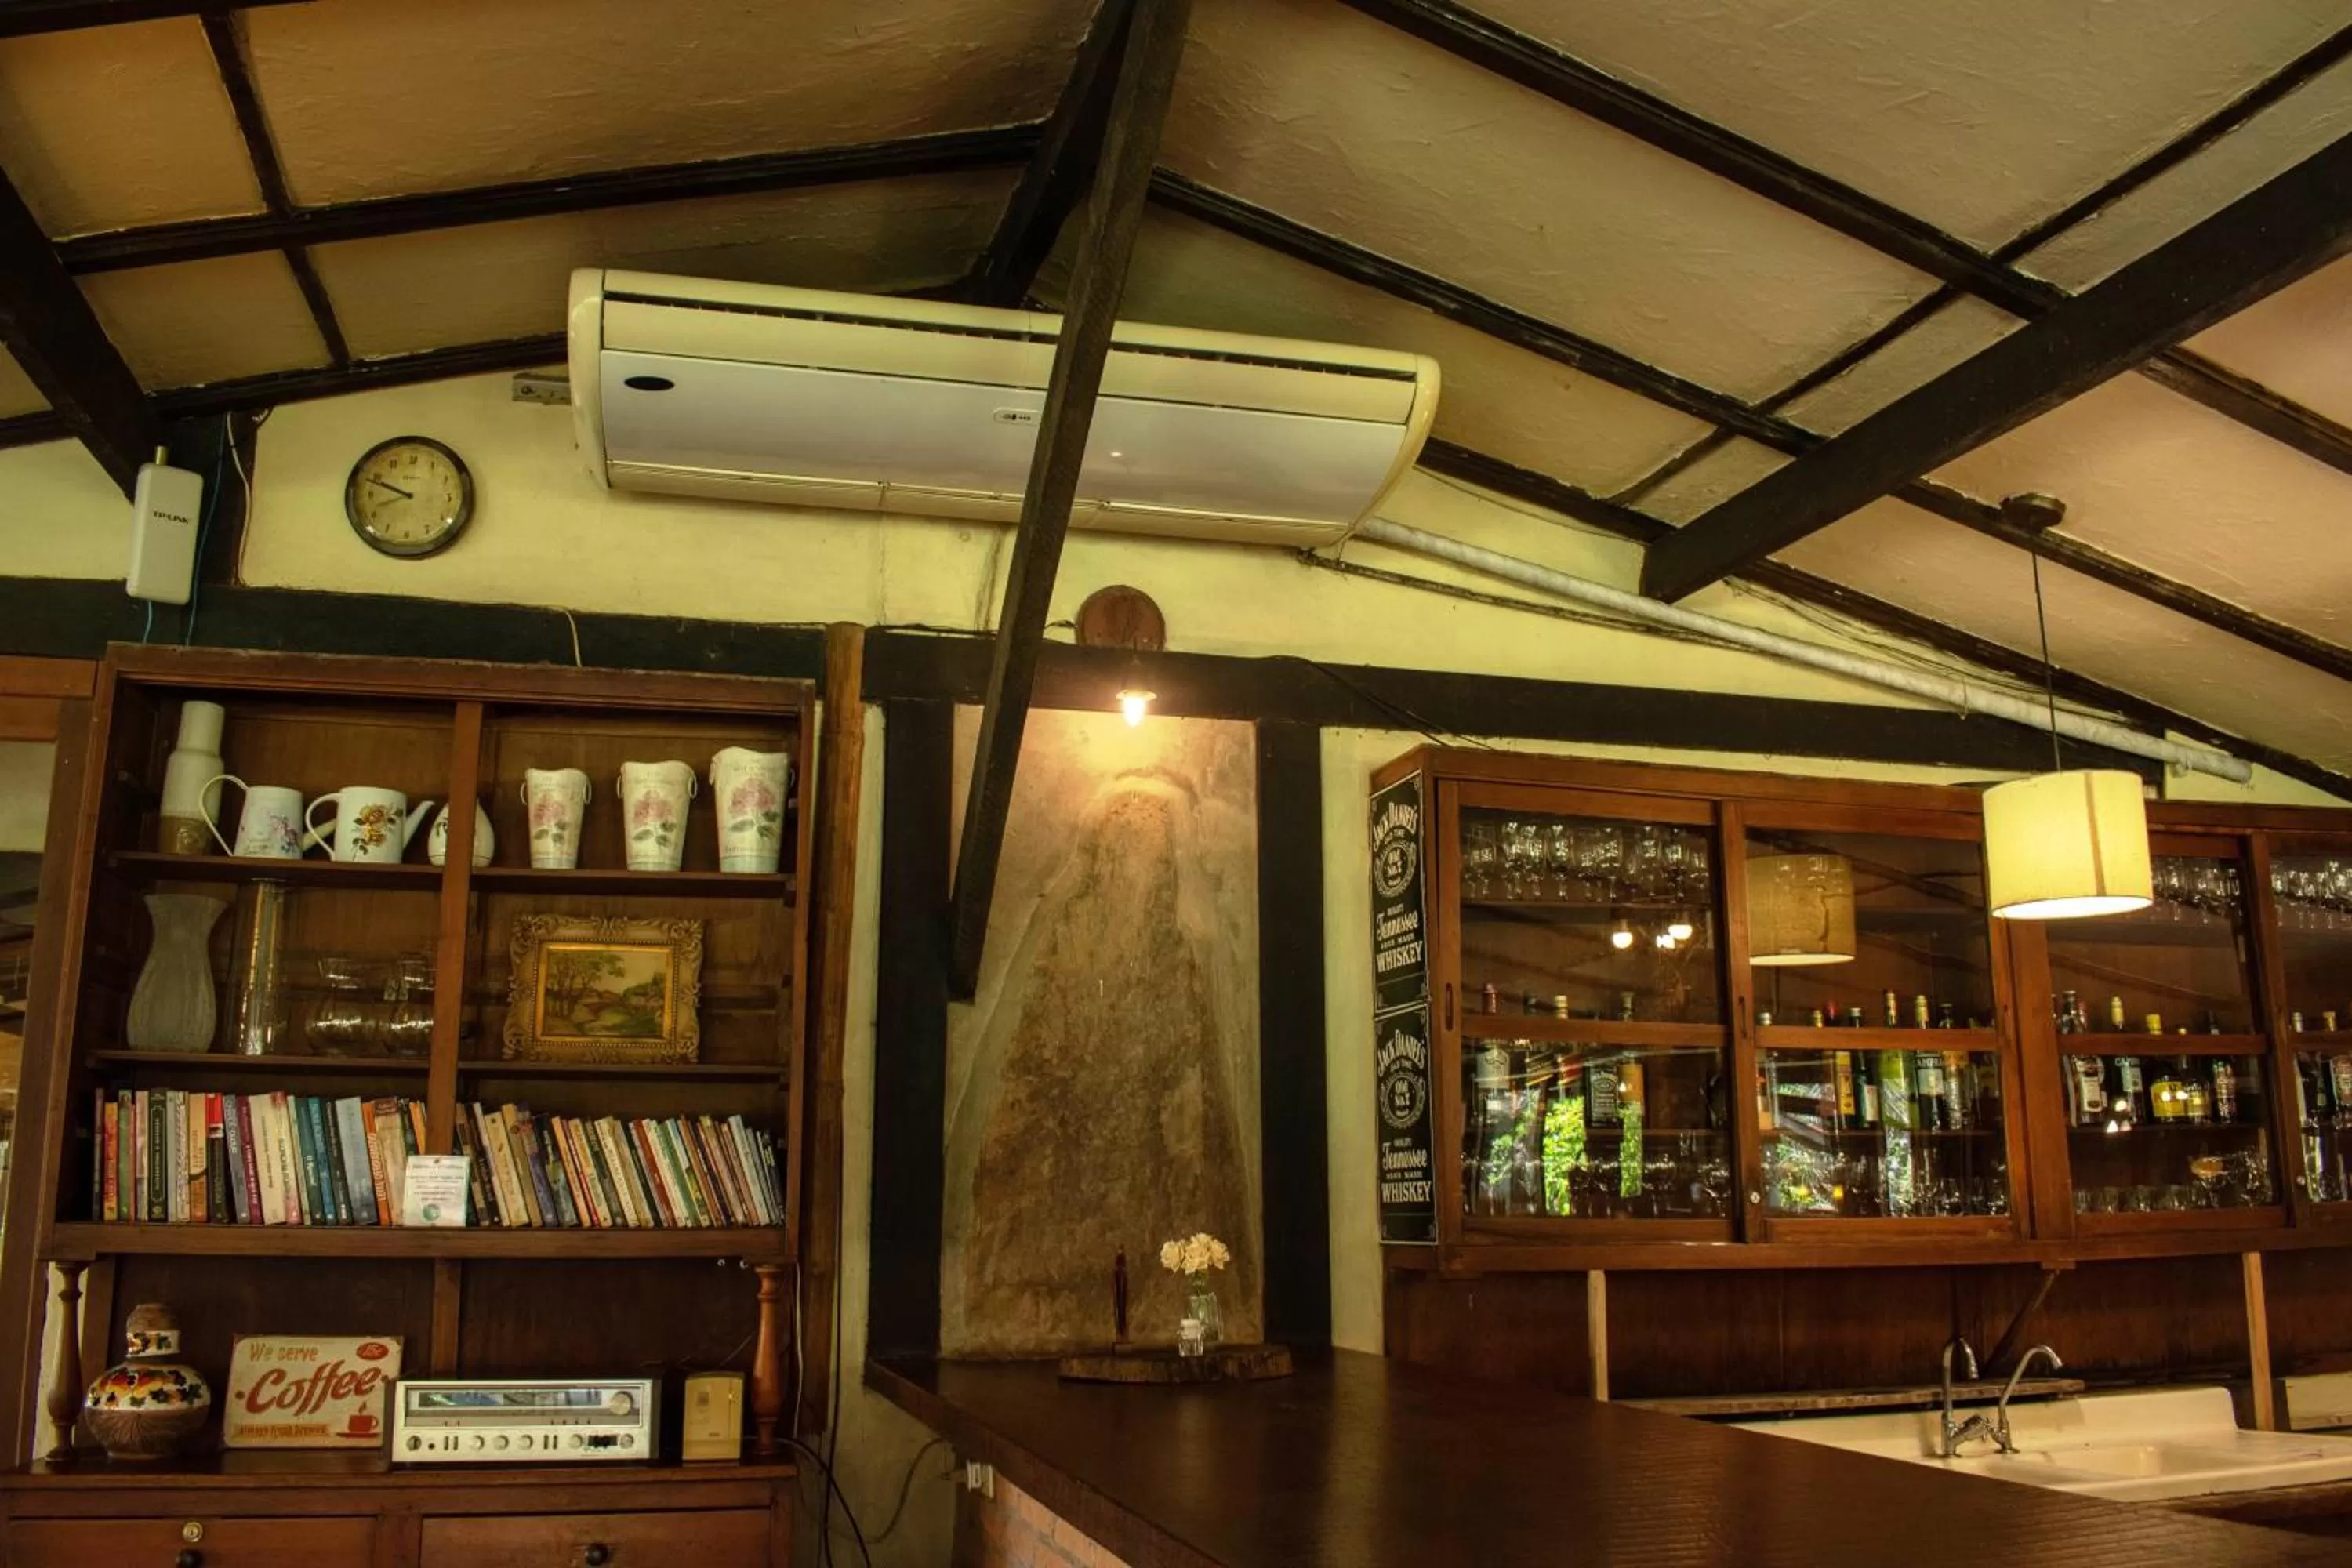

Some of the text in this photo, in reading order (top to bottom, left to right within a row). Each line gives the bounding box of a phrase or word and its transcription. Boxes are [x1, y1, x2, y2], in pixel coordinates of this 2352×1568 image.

[153, 510, 189, 525] TP-LINK
[1376, 940, 1423, 972] WHISKEY
[1382, 1142, 1428, 1171] Tennessee
[1381, 1180, 1432, 1203] WHISKEY
[249, 1341, 319, 1362] We serve
[245, 1359, 382, 1417] Coffee
